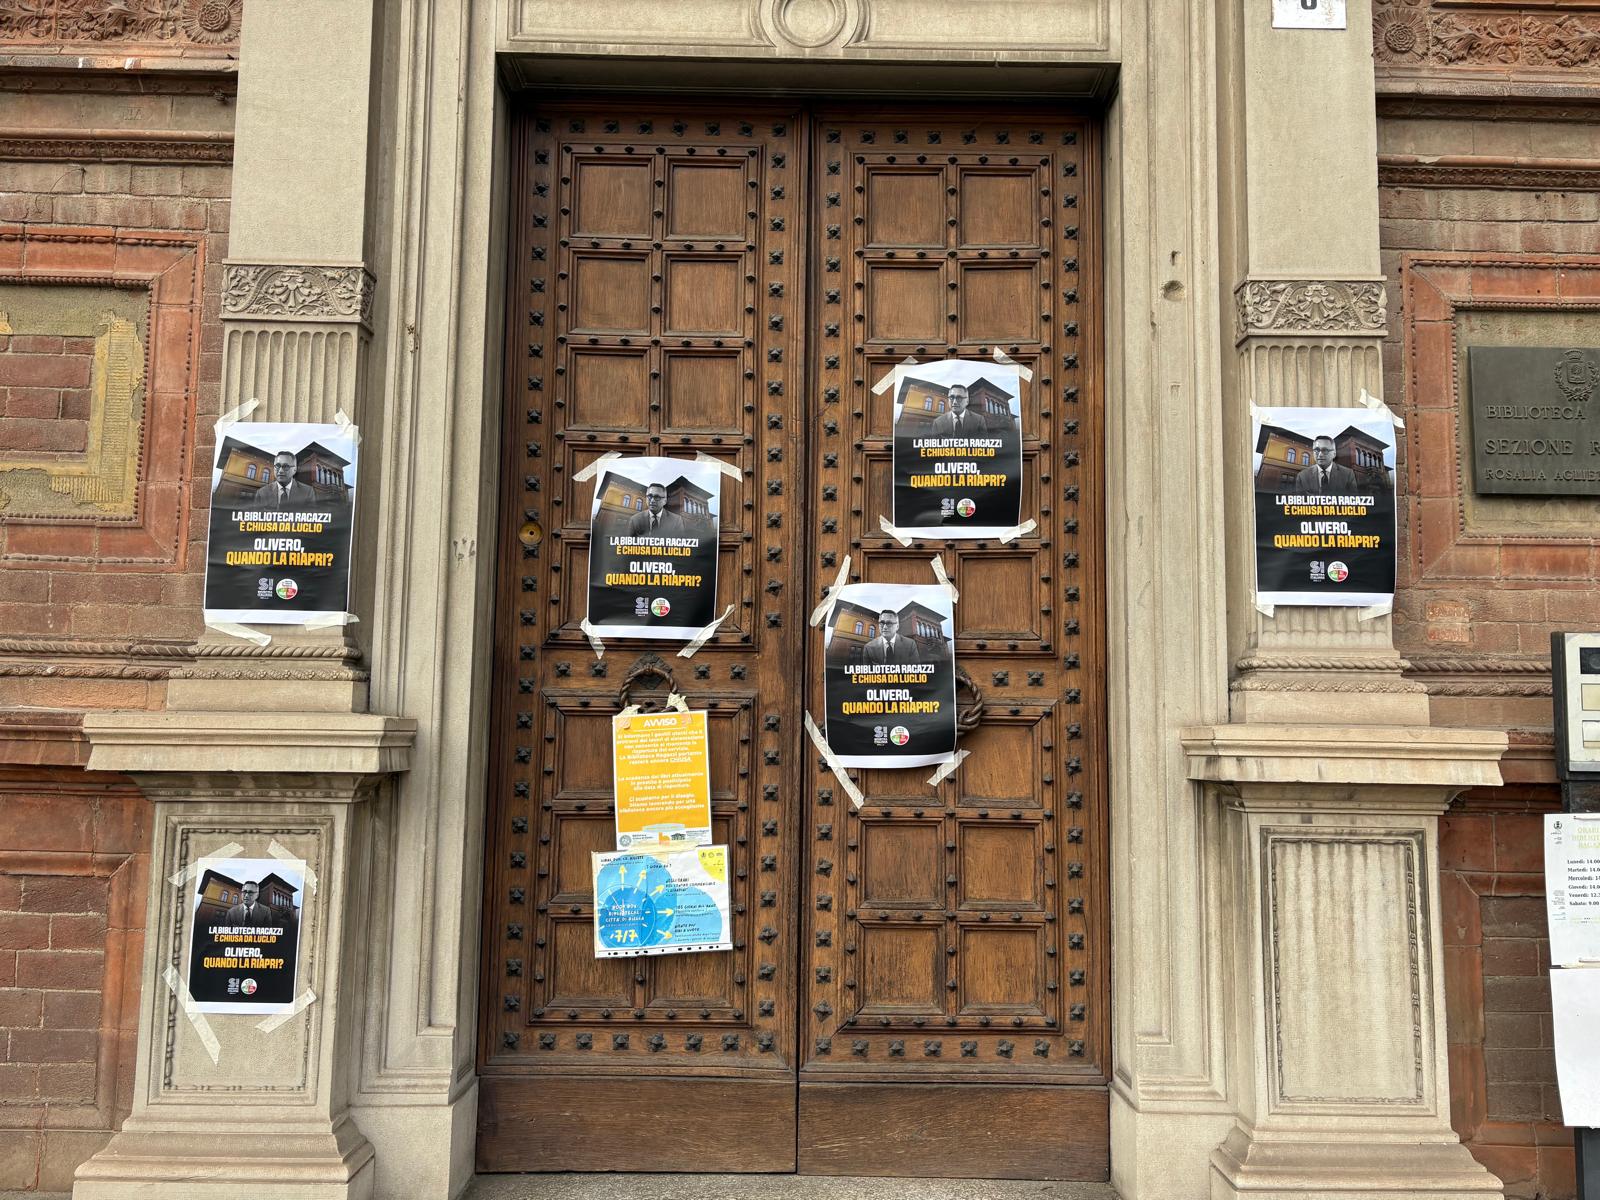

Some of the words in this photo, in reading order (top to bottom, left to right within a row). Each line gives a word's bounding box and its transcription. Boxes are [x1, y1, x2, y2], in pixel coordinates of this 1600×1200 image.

[1486, 406, 1586, 420] BIBLIOTECA
[913, 439, 923, 448] LA
[924, 439, 969, 448] BIBLIOTECA
[970, 439, 1002, 448] RAGAZZI
[1485, 440, 1574, 456] SEZIONE
[927, 448, 956, 457] CHIUSA
[956, 448, 967, 456] DA
[968, 448, 995, 456] LUGLIO
[934, 462, 980, 476] OLIVERO,
[1486, 469, 1548, 481] ROSALIA
[910, 475, 951, 488] QUANDO
[952, 474, 966, 486] LA
[967, 474, 1006, 487] RIAPRI?
[1276, 495, 1287, 505] LA
[1288, 495, 1338, 505] BIBLIOTECA
[1338, 496, 1375, 506] RAGAZZI
[1291, 506, 1322, 515] CHIUSA
[1324, 506, 1335, 515] DA
[1336, 506, 1367, 515] LUGLIO
[232, 512, 244, 521] LA
[244, 512, 294, 522] BIBLIOTECA
[295, 513, 331, 523] RAGAZZI
[246, 522, 277, 532] CHIUSA
[279, 522, 290, 532] DA
[292, 523, 323, 533] LUGLIO
[1300, 522, 1352, 536] OLIVERO,
[254, 538, 304, 553] OLIVERO,
[610, 537, 619, 546] LA
[620, 537, 664, 546] BIBLIOTECA
[666, 538, 699, 548] RAGAZZI
[1274, 535, 1320, 548] QUANDO
[1322, 535, 1336, 547] LA
[1337, 536, 1380, 548] RIAPRI?
[622, 546, 650, 555] CHIUSA
[652, 547, 662, 556] DA
[664, 547, 691, 556] LUGLIO
[226, 552, 271, 566] QUANDO
[273, 552, 287, 565] LA
[289, 553, 334, 566] RIAPRI?
[630, 561, 676, 576] OLIVERO,
[606, 573, 646, 586] QUANDO
[648, 574, 660, 586] LA
[662, 575, 702, 587] RIAPRI?
[844, 665, 854, 674] LA
[855, 665, 900, 674] BIBLIOTECA
[901, 664, 935, 673] RAGAZZI
[858, 674, 887, 683] CHIUSA
[888, 674, 899, 683] DA
[899, 674, 927, 683] LUGLIO
[866, 689, 912, 702] OLIVERO,
[842, 702, 884, 715] QUANDO
[885, 702, 898, 713] LA
[900, 702, 940, 713] RIAPRI?
[644, 718, 677, 727] AVVISO
[218, 926, 255, 935] BIBLIOTECA
[224, 947, 263, 959] OLIVERO,
[204, 957, 238, 969] QUANDO
[238, 958, 250, 969] LA
[250, 958, 285, 969] RIAPRI?
